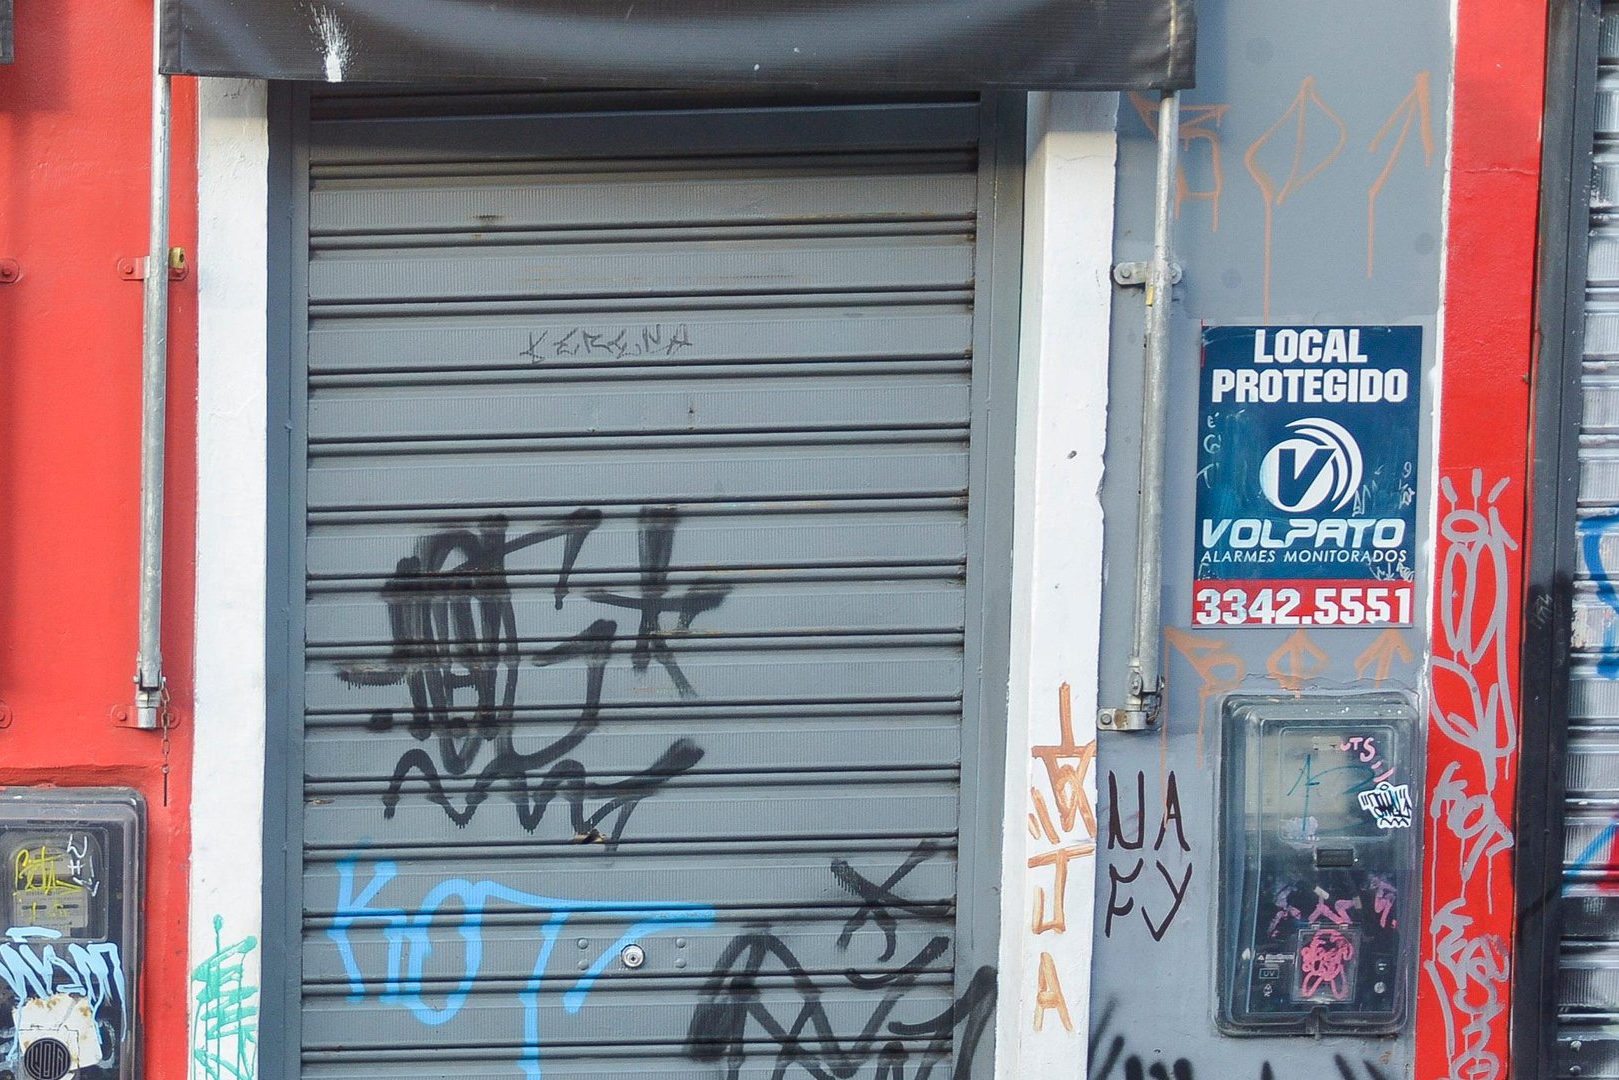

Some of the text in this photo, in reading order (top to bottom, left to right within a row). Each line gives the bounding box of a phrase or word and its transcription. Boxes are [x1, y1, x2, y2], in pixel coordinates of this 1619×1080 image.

[1254, 329, 1367, 363] LOCAL
[1212, 369, 1408, 403] PROTEGIDO
[1201, 518, 1406, 548] VOLPATO
[1200, 550, 1408, 564] ALARMES MONITORADOS
[1196, 588, 1411, 625] 3342.5551
